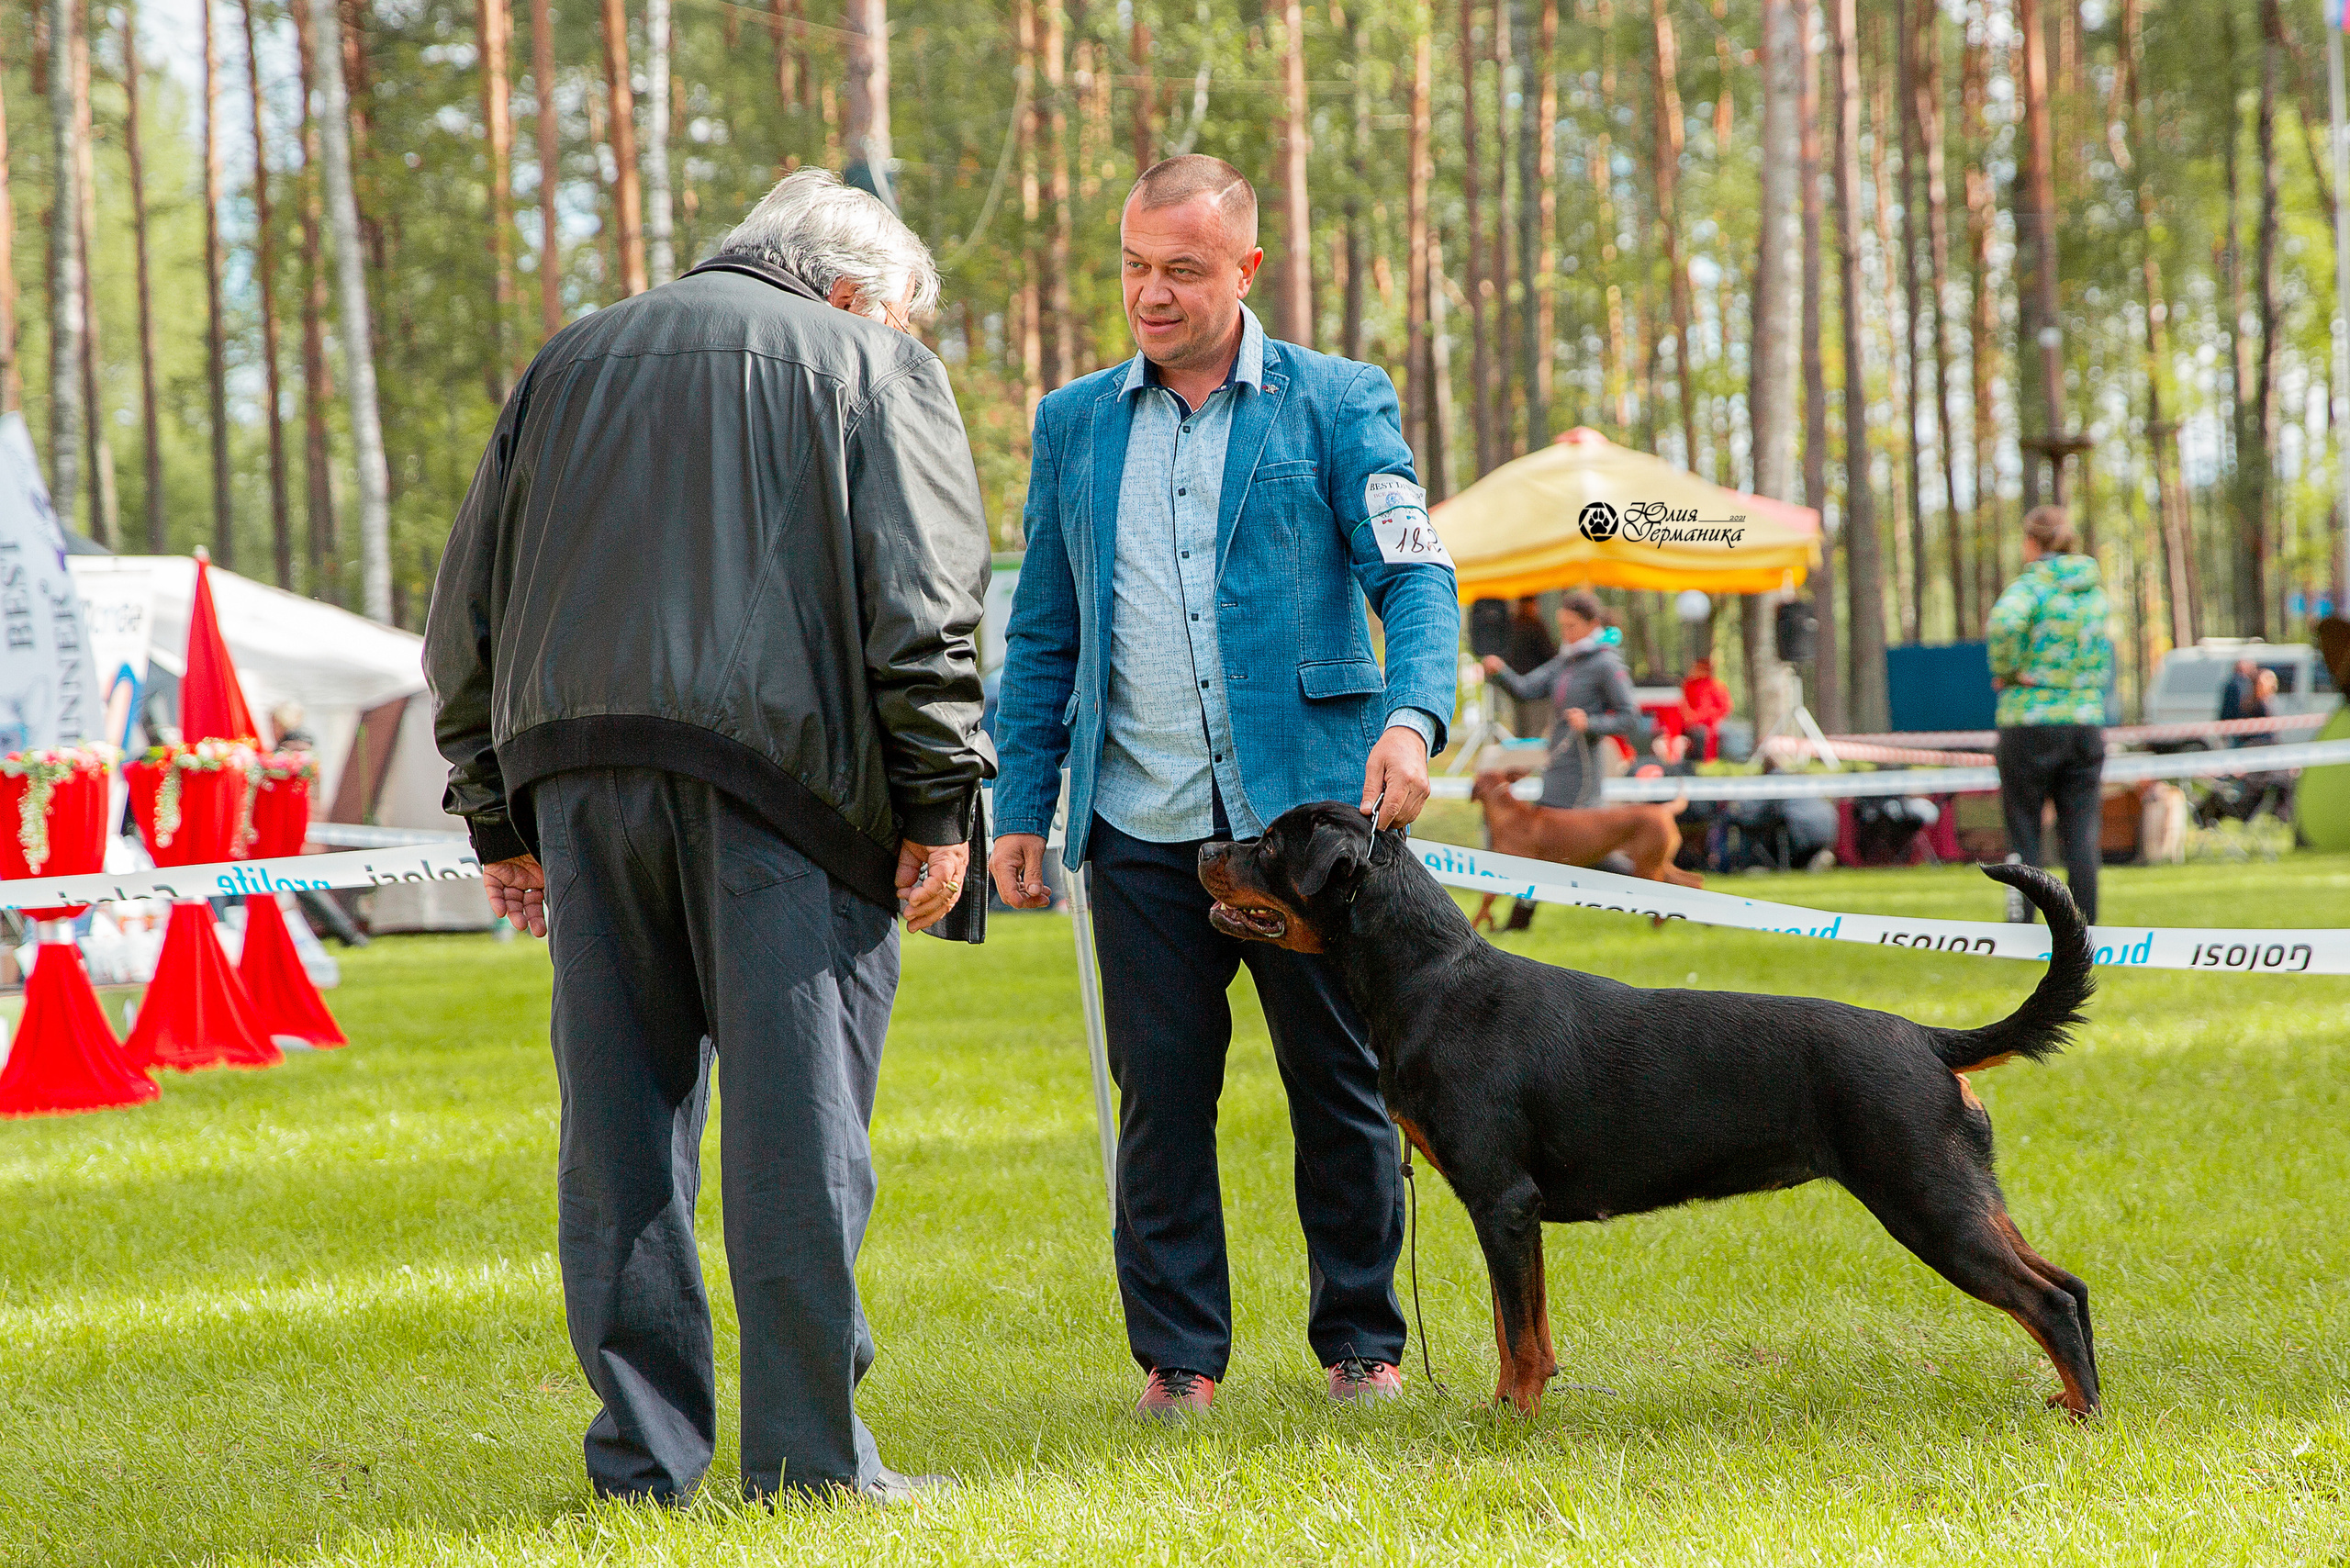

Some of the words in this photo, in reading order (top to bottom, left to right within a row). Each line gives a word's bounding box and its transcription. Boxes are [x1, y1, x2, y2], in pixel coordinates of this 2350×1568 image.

[1370, 481, 1394, 491] BEST
[52, 593, 81, 742] INNER
[2189, 943, 2314, 971] Golosi
